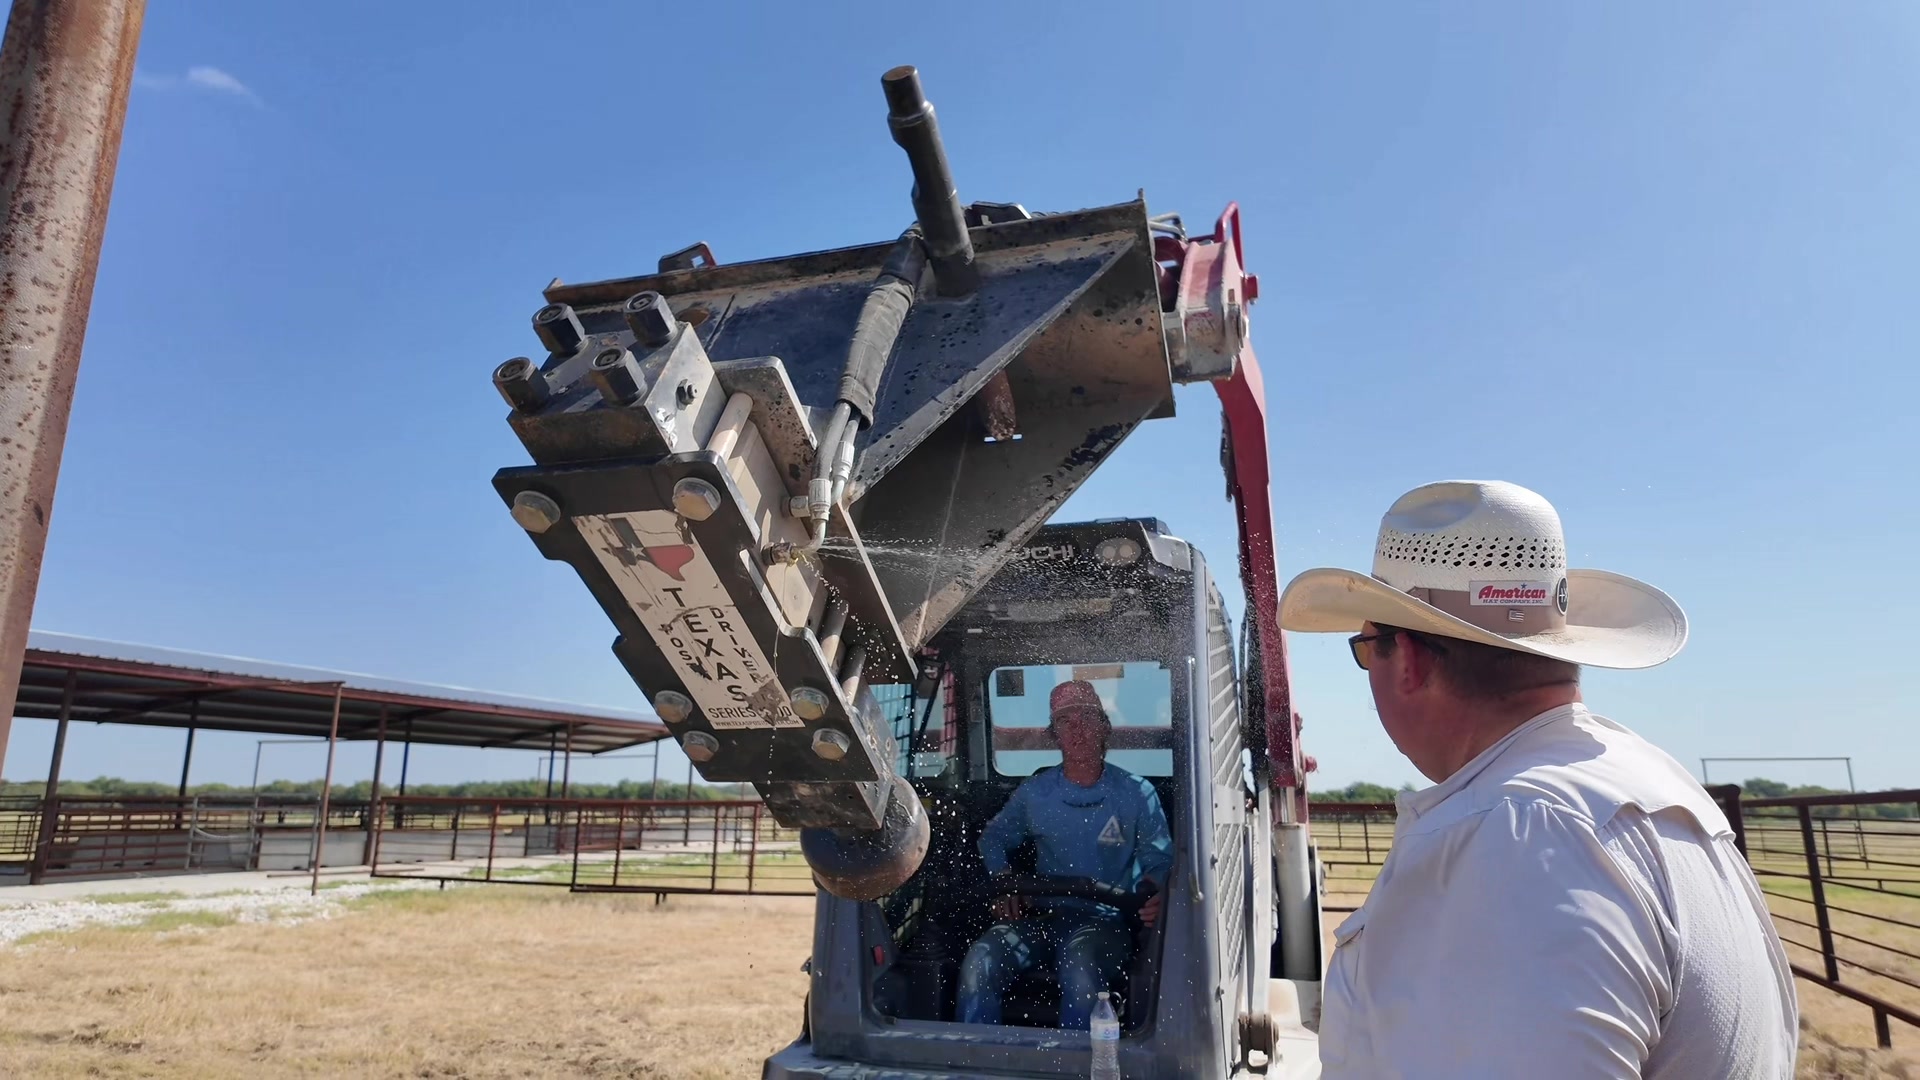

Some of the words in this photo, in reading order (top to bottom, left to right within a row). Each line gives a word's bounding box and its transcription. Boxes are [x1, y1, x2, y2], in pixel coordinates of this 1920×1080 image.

[1478, 584, 1546, 600] American
[662, 587, 748, 702] TEXAS
[708, 706, 757, 719] SERIES
